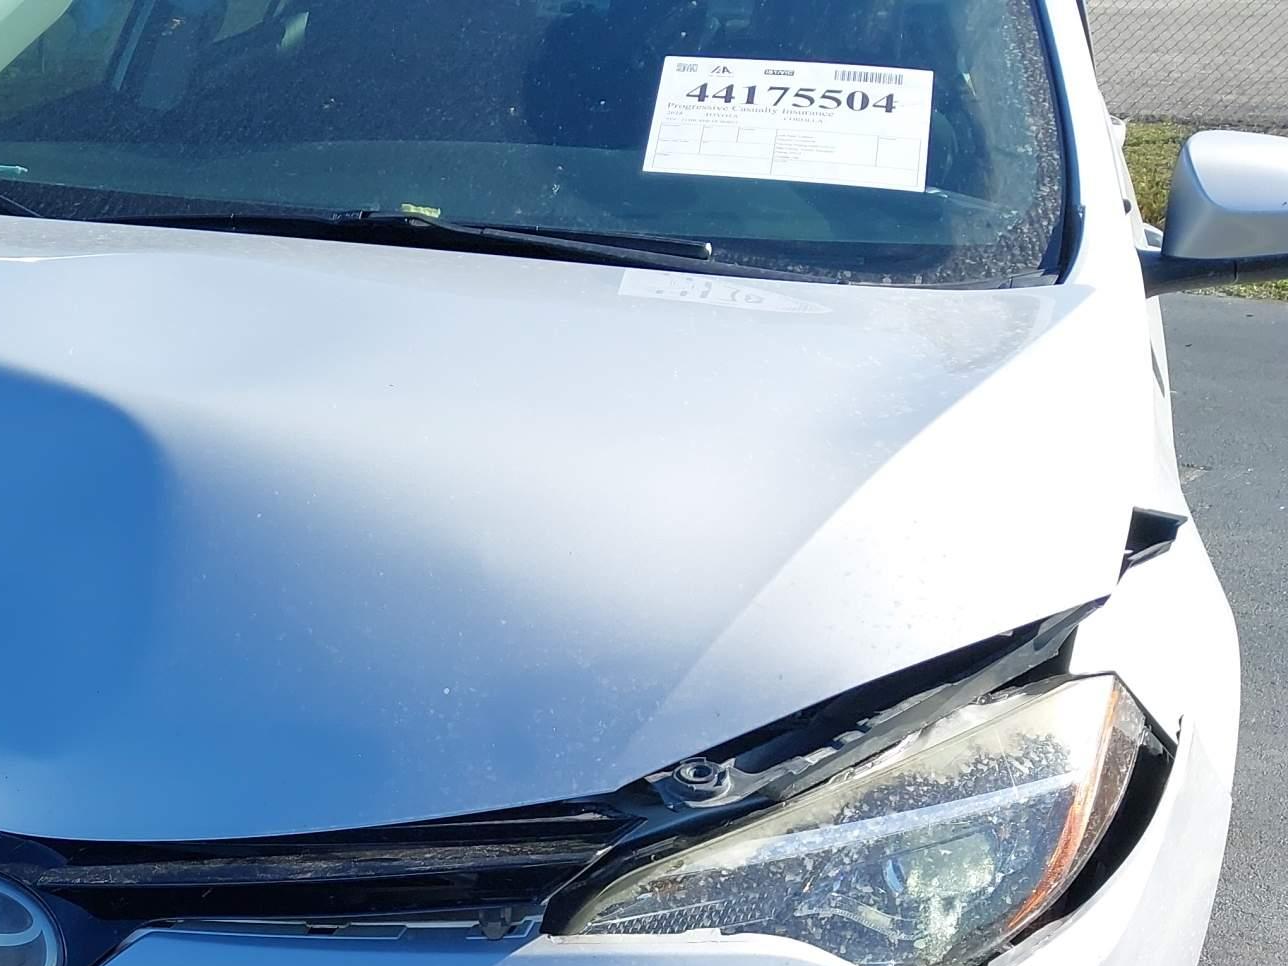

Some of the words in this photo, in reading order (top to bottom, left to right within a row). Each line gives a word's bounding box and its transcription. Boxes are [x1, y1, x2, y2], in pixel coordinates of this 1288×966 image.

[685, 81, 898, 113] 44175504
[667, 102, 729, 112] Progressive
[731, 104, 778, 116] Casualty
[781, 108, 835, 118] Insurance
